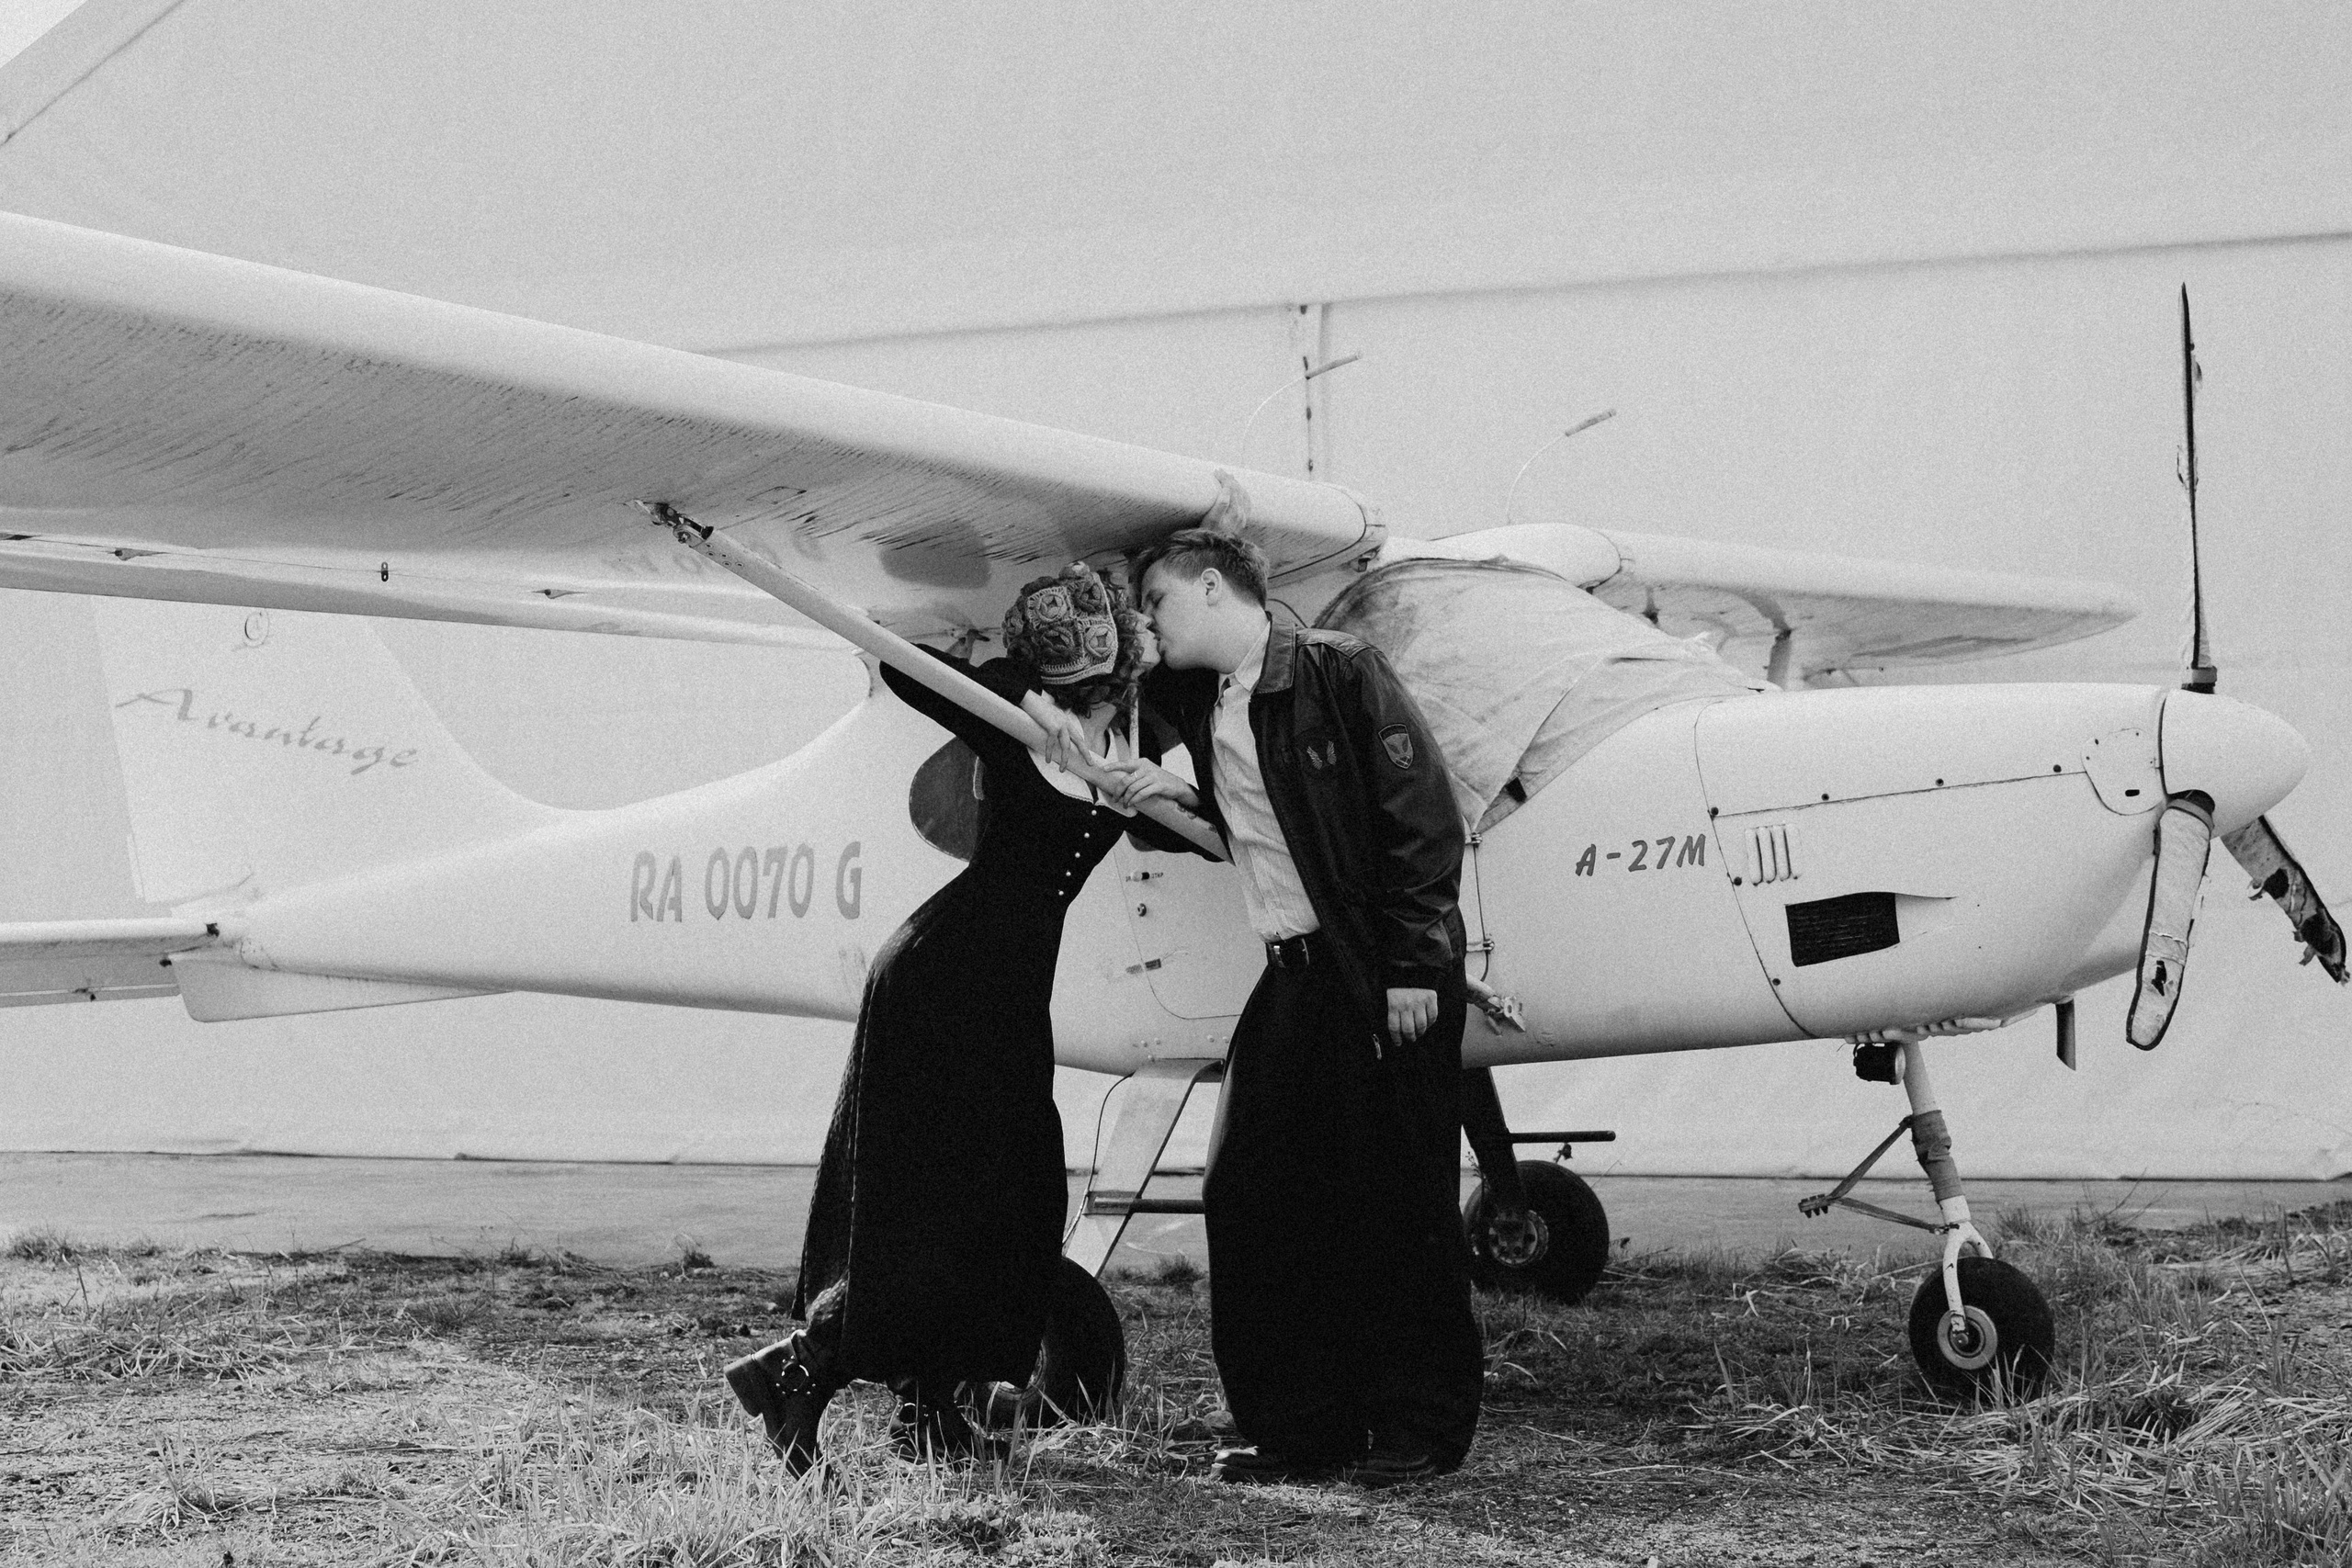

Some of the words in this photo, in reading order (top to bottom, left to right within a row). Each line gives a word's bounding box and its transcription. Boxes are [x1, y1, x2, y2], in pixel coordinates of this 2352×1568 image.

[116, 688, 419, 775] Avantage
[630, 851, 683, 923] RA
[705, 842, 814, 920] 0070
[835, 840, 862, 919] G
[1575, 834, 1706, 876] A-27M
